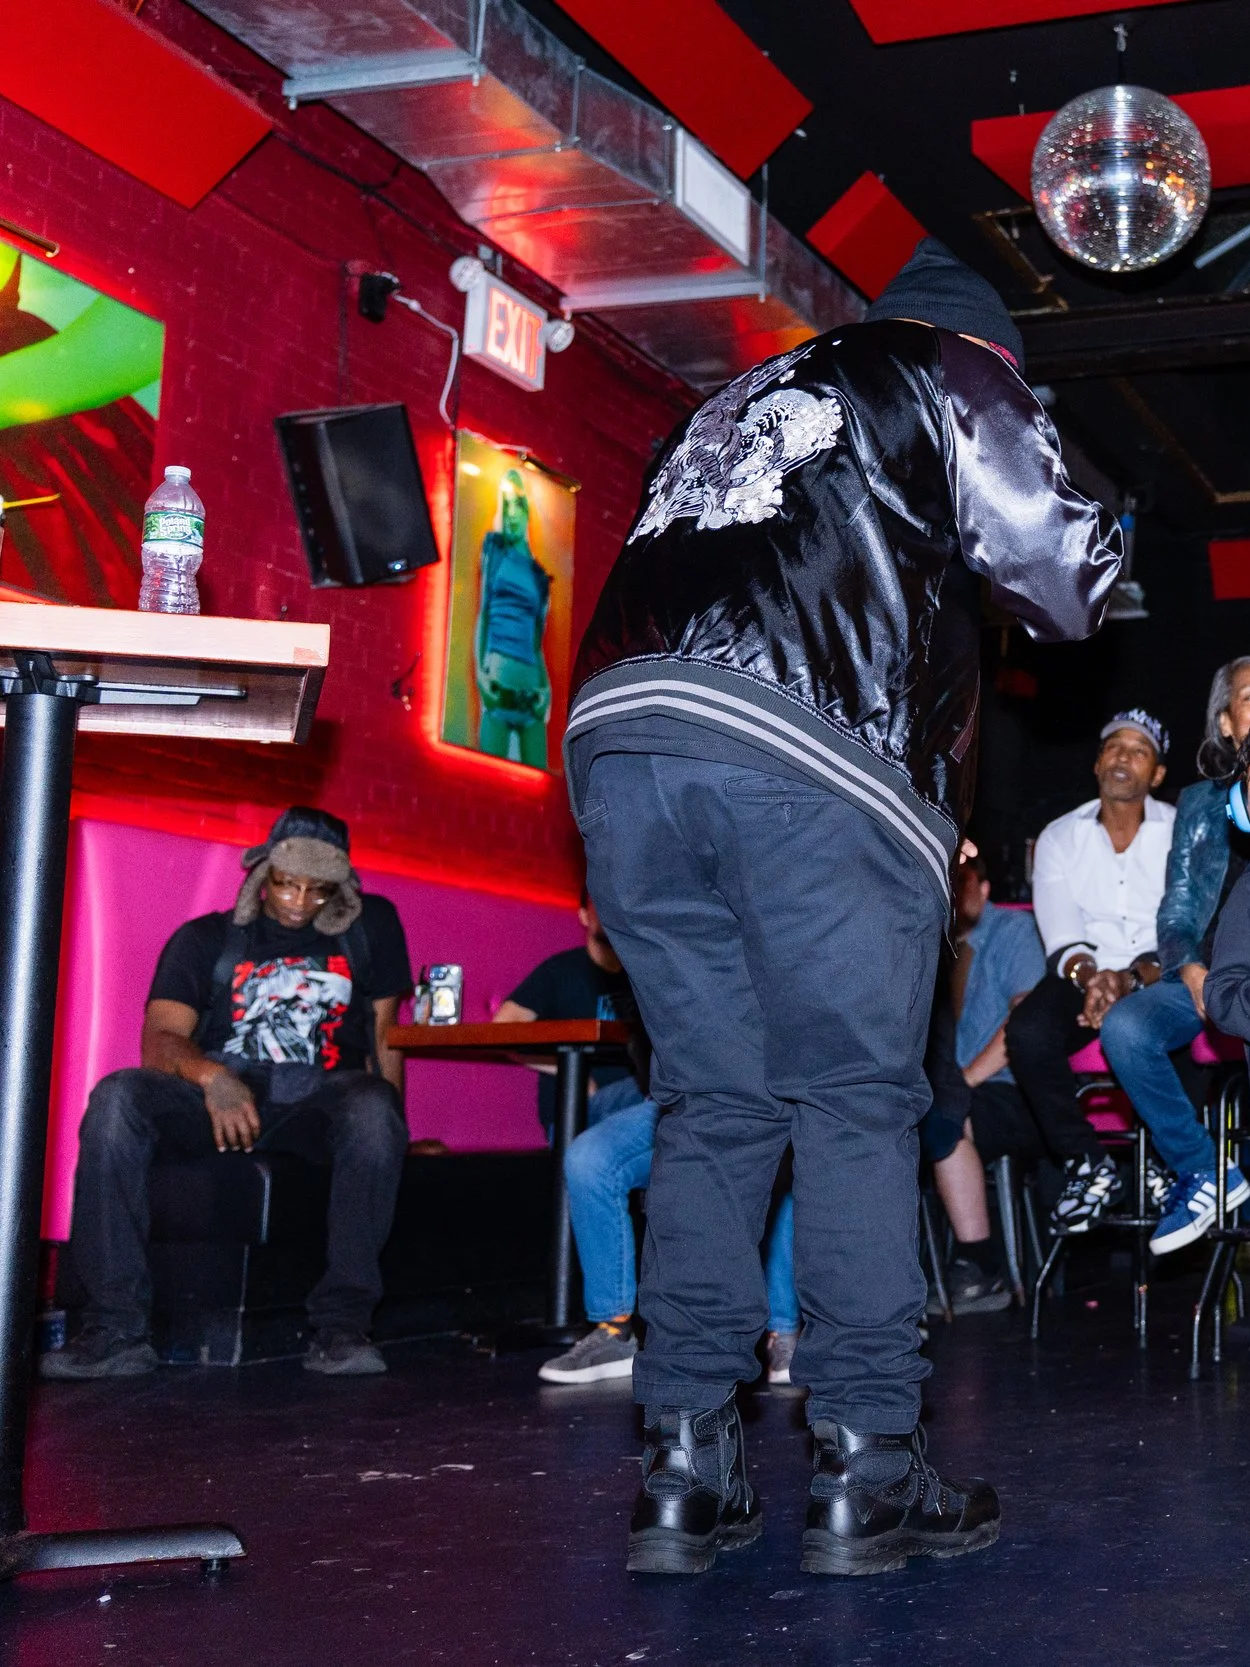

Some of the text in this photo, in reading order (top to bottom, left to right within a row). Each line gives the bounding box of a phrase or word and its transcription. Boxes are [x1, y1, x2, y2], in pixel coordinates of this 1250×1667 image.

[486, 287, 542, 379] EXIT
[159, 517, 191, 528] Poland
[159, 525, 193, 538] Spring
